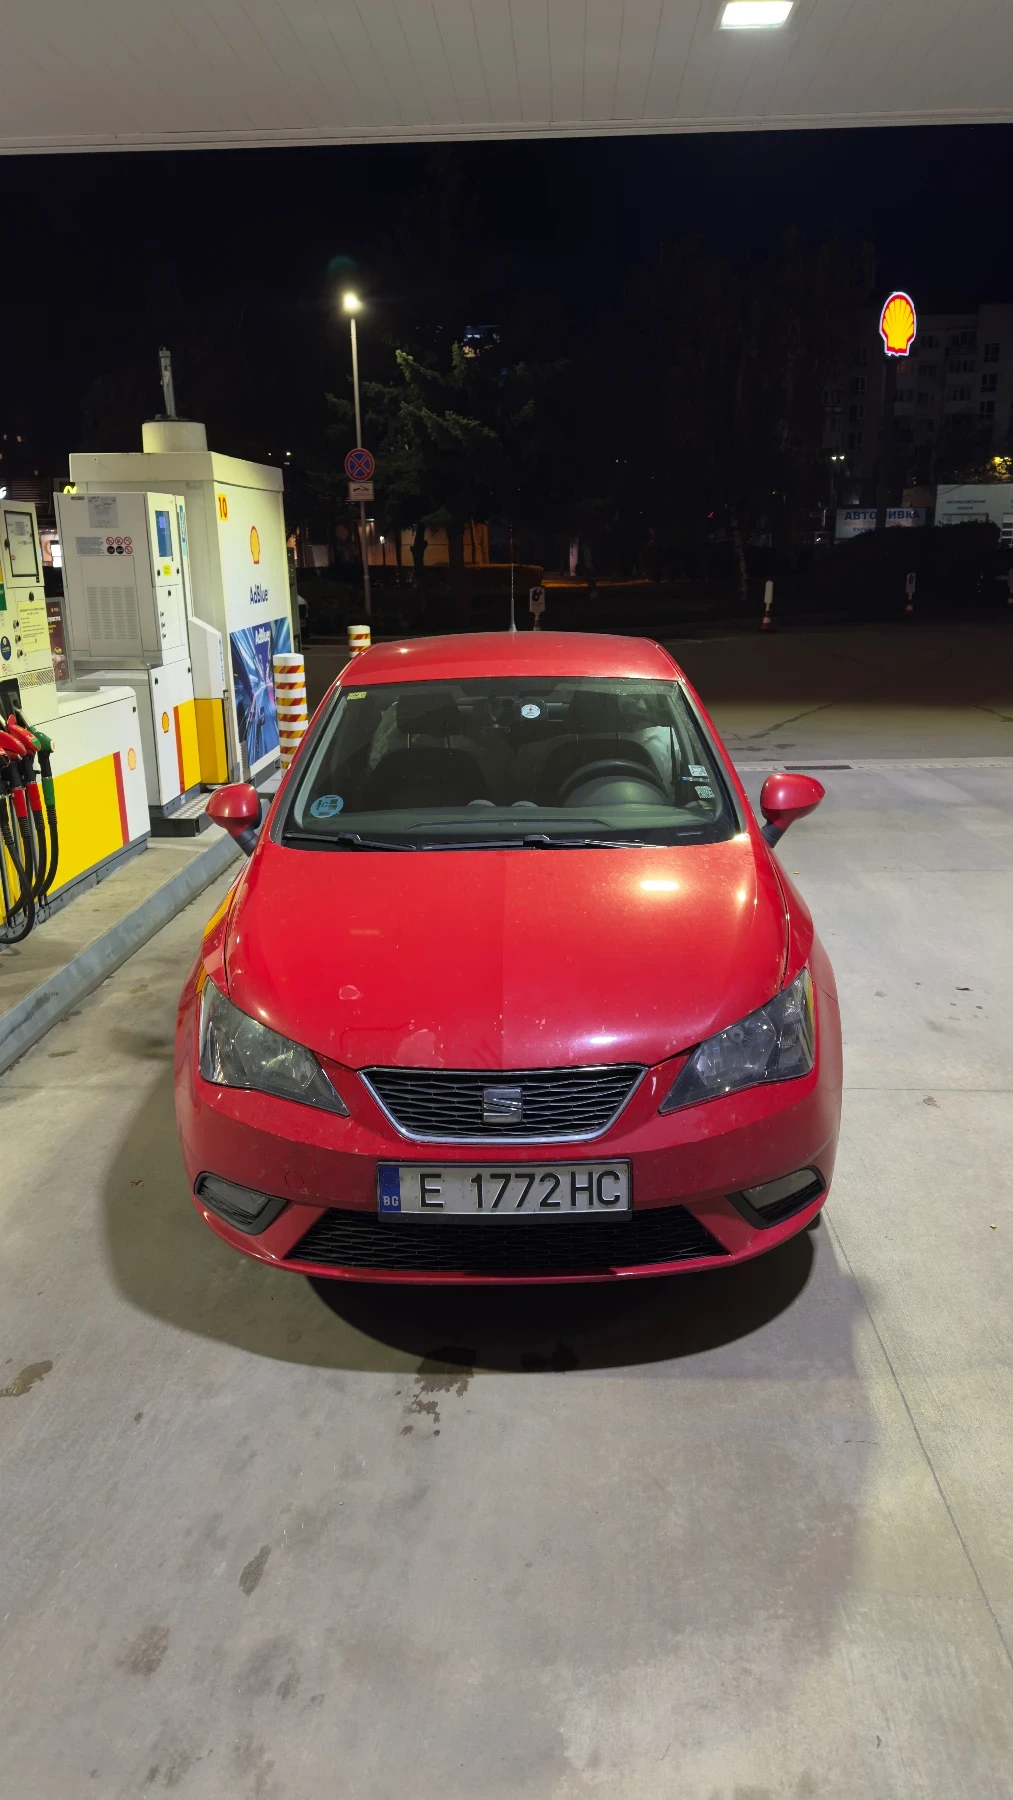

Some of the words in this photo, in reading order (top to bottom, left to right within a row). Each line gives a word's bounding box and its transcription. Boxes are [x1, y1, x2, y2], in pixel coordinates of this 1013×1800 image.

[218, 496, 228, 518] 10
[844, 510, 920, 521] АВТОИВКА
[250, 583, 268, 605] AdBlue
[255, 627, 271, 645] AdBlue
[419, 1173, 444, 1208] E
[470, 1172, 561, 1209] 1772
[570, 1170, 621, 1207] HC
[383, 1195, 399, 1207] BG
